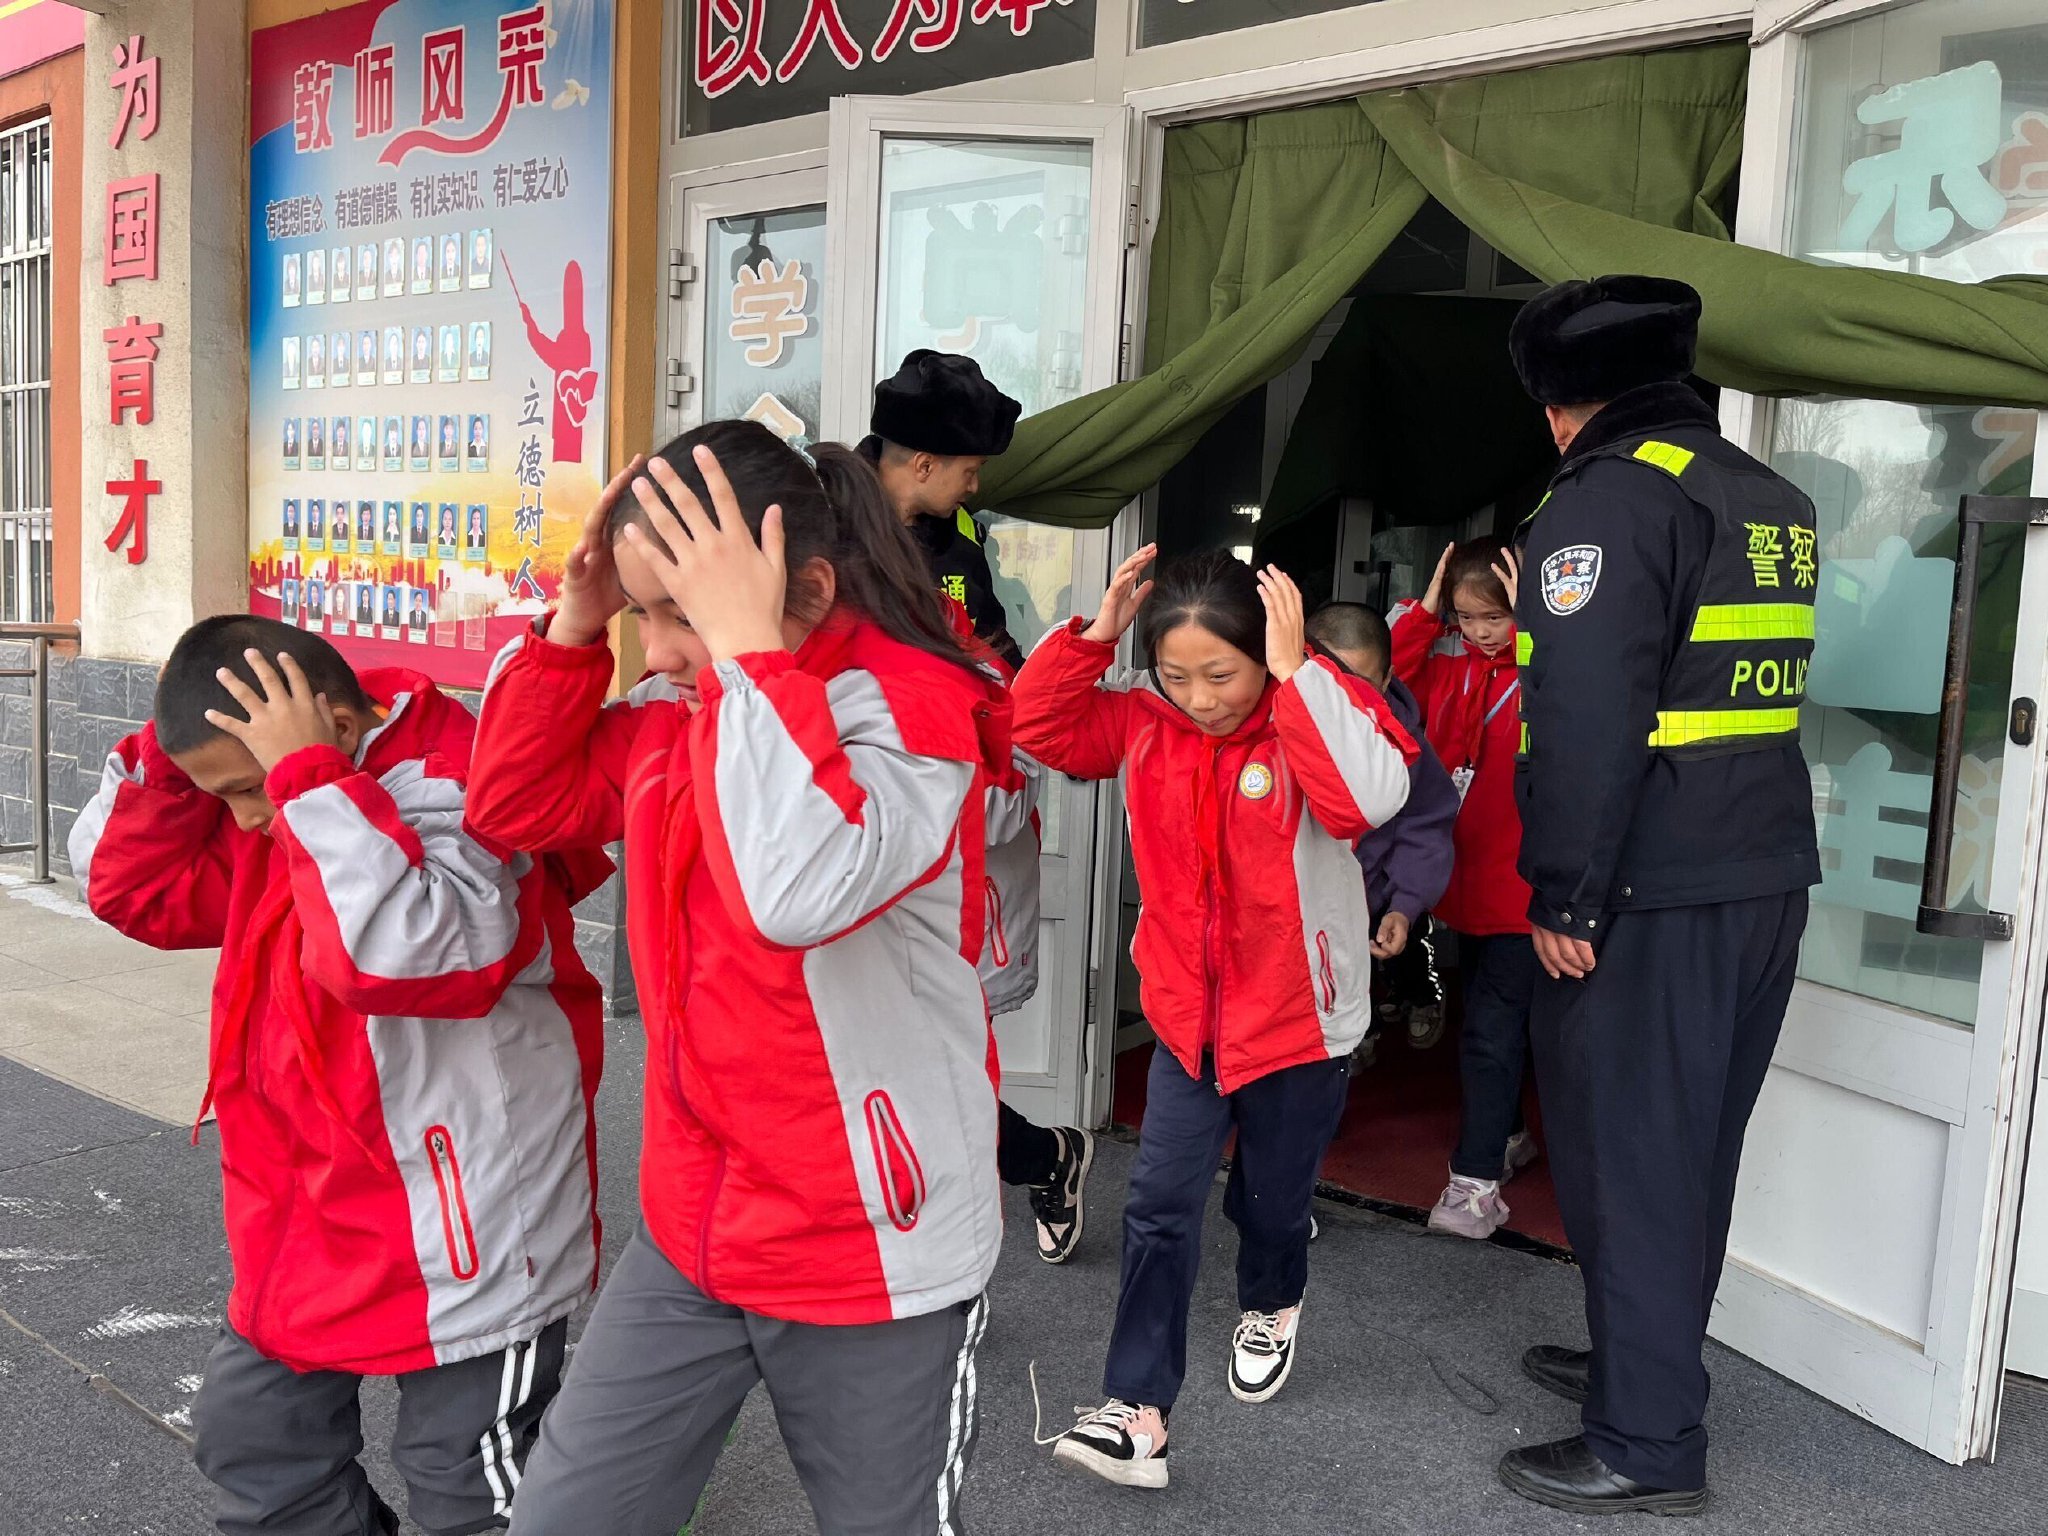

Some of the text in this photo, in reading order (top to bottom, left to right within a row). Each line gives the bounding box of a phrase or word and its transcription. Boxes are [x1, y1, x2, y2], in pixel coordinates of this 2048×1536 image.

[293, 3, 548, 154] 教师风采
[104, 35, 163, 566] 为国育才
[511, 376, 546, 599] 立德树人
[1743, 521, 1817, 588] 警察
